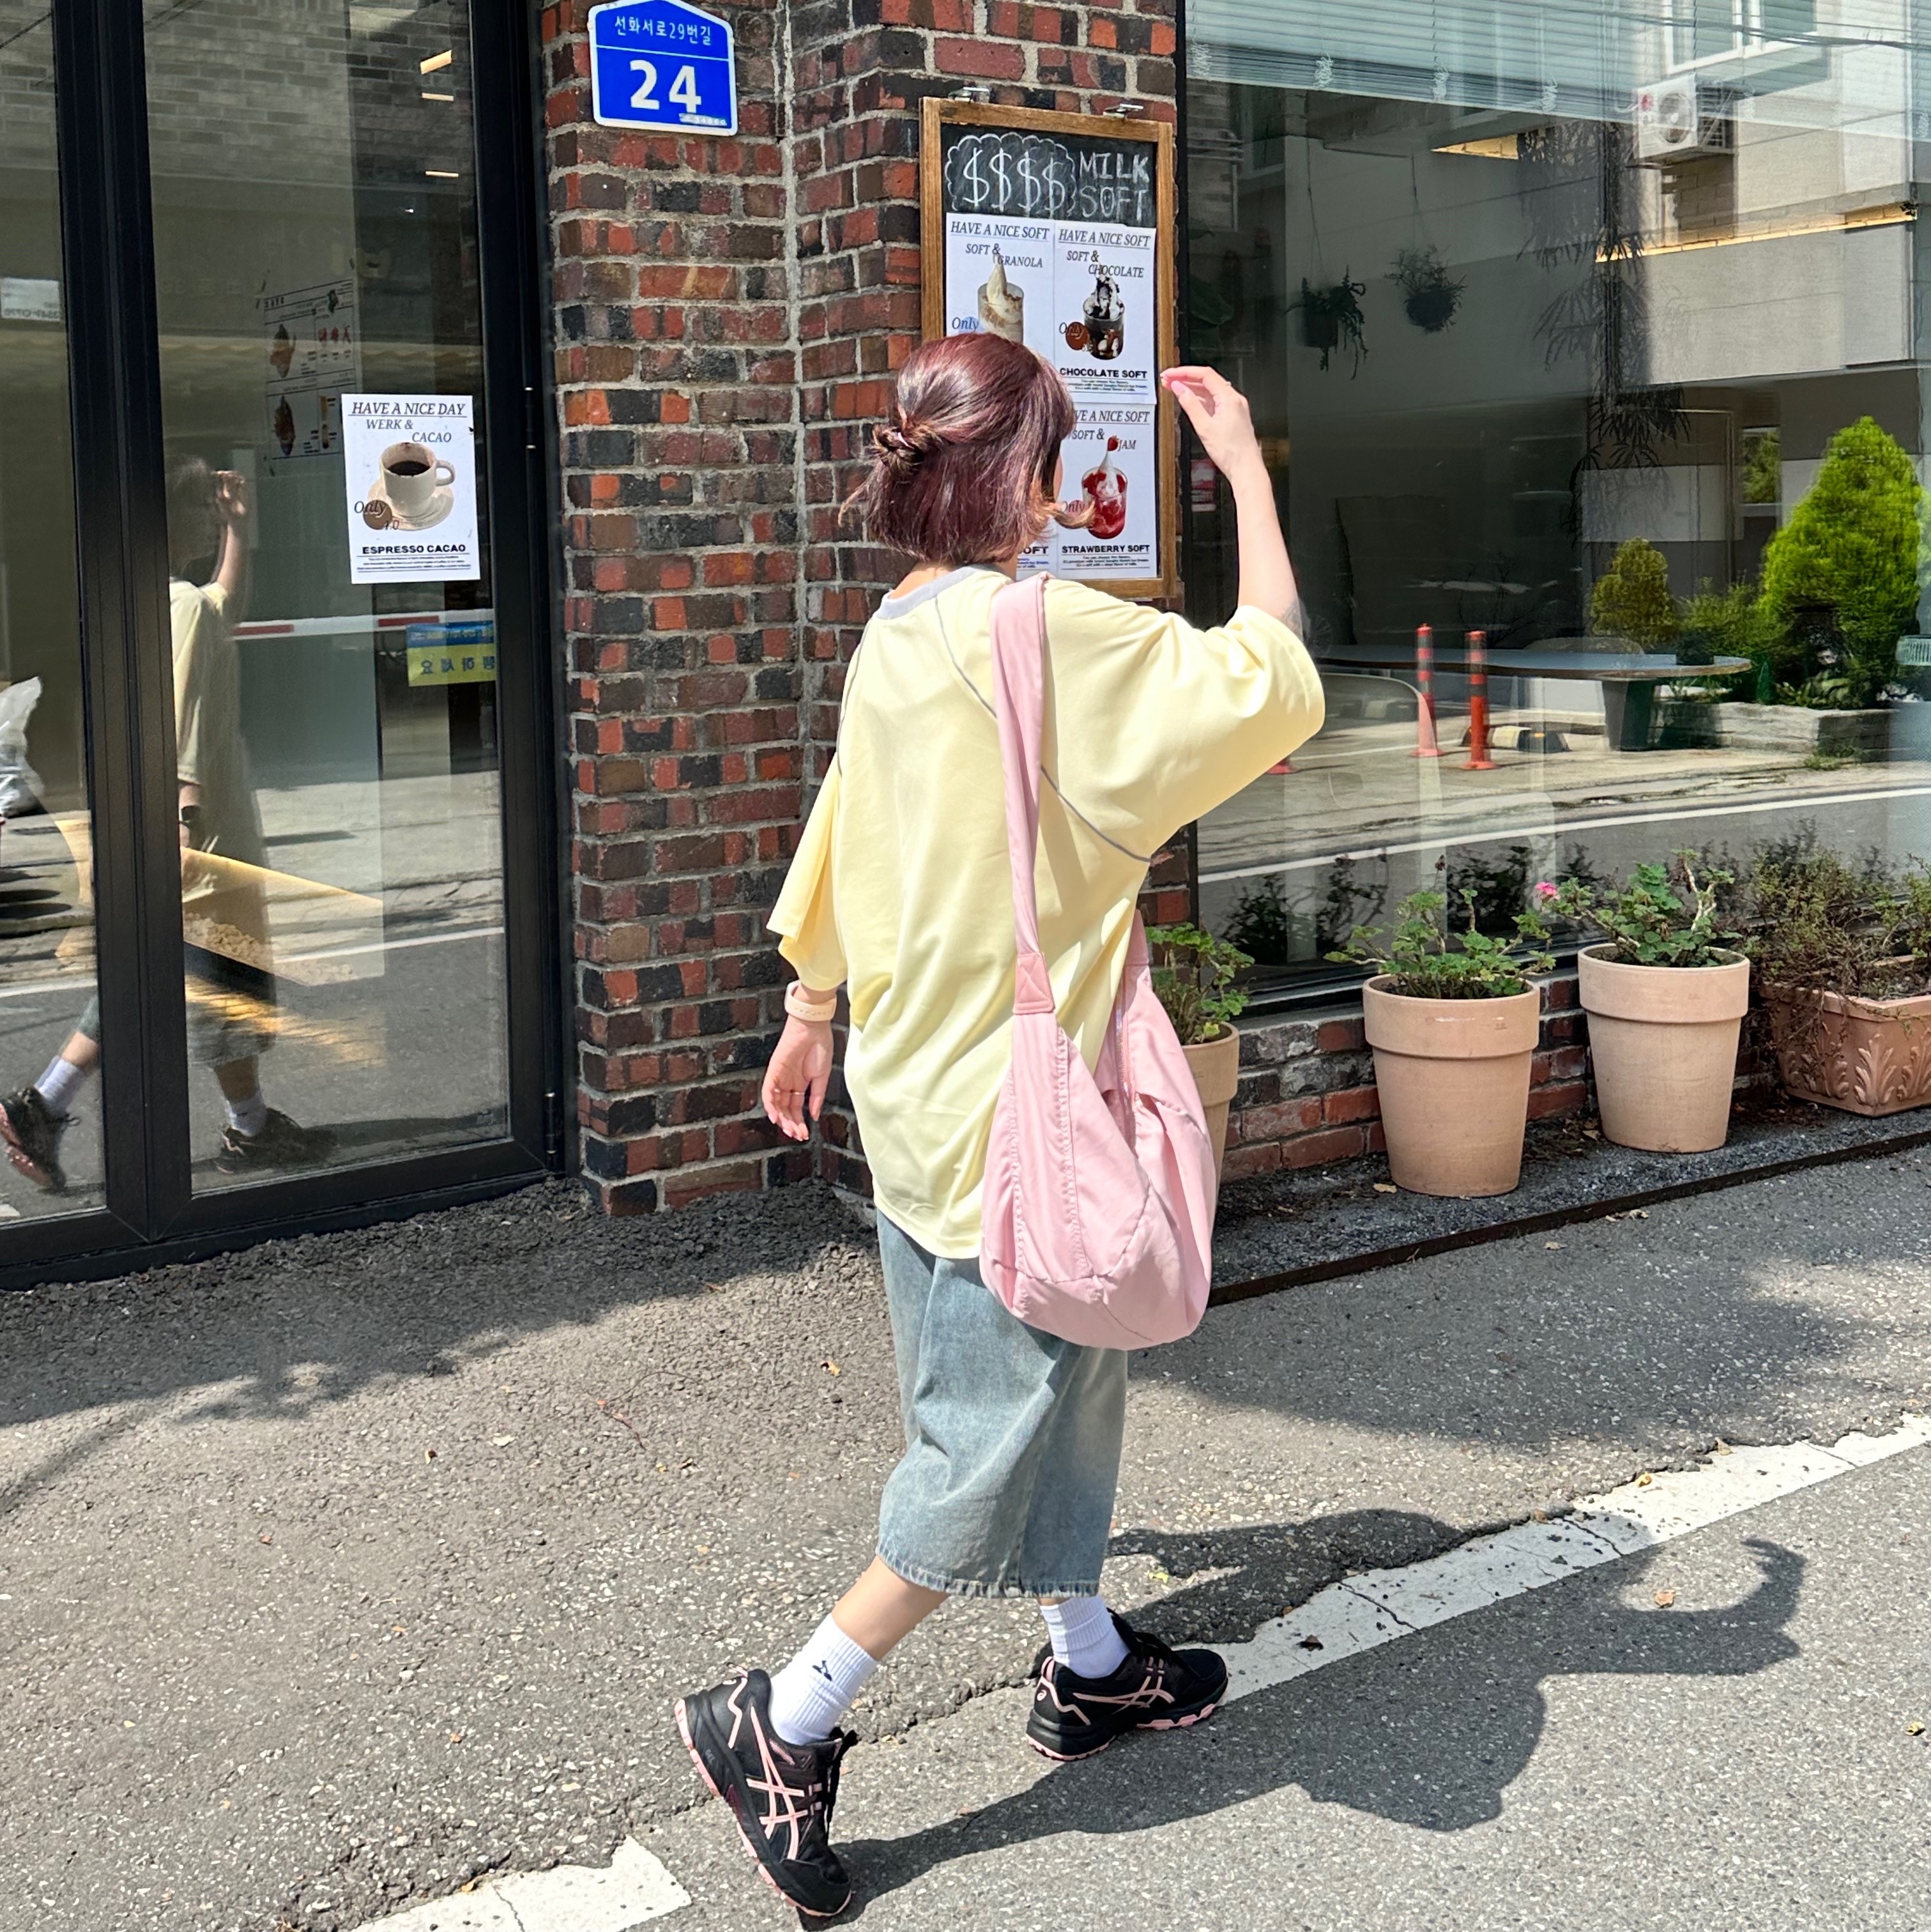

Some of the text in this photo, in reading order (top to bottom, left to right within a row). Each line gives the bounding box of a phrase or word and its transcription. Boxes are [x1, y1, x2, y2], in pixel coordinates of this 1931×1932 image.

[614, 16, 711, 45] 선화서로29번길
[630, 59, 701, 113] 24
[1080, 151, 1150, 183] MILK
[1080, 185, 1147, 223] SOFT
[950, 221, 1049, 240] HAVE A NICE SOFT
[1058, 229, 1150, 247] HAVE A NICE SOFT
[965, 243, 1001, 255] SOFT &
[998, 256, 1043, 268] GRANOLA
[1066, 250, 1099, 262] SOFT &
[1088, 264, 1144, 278] CHOCOLATE
[952, 316, 979, 332] Only
[1060, 367, 1147, 378] CHOCOLATE SOFT
[352, 402, 466, 415] HAVE A NICE DAY
[1075, 410, 1150, 422] VE A NICE SOFT
[366, 419, 414, 429] WERK &
[411, 432, 452, 443] CACAO
[1071, 428, 1105, 440] SOFT &
[355, 500, 387, 517] Only
[362, 544, 466, 555] ESPRESSO CACAO
[1018, 546, 1049, 555] OFT
[1062, 544, 1150, 553] STRAWBERRY SOFT
